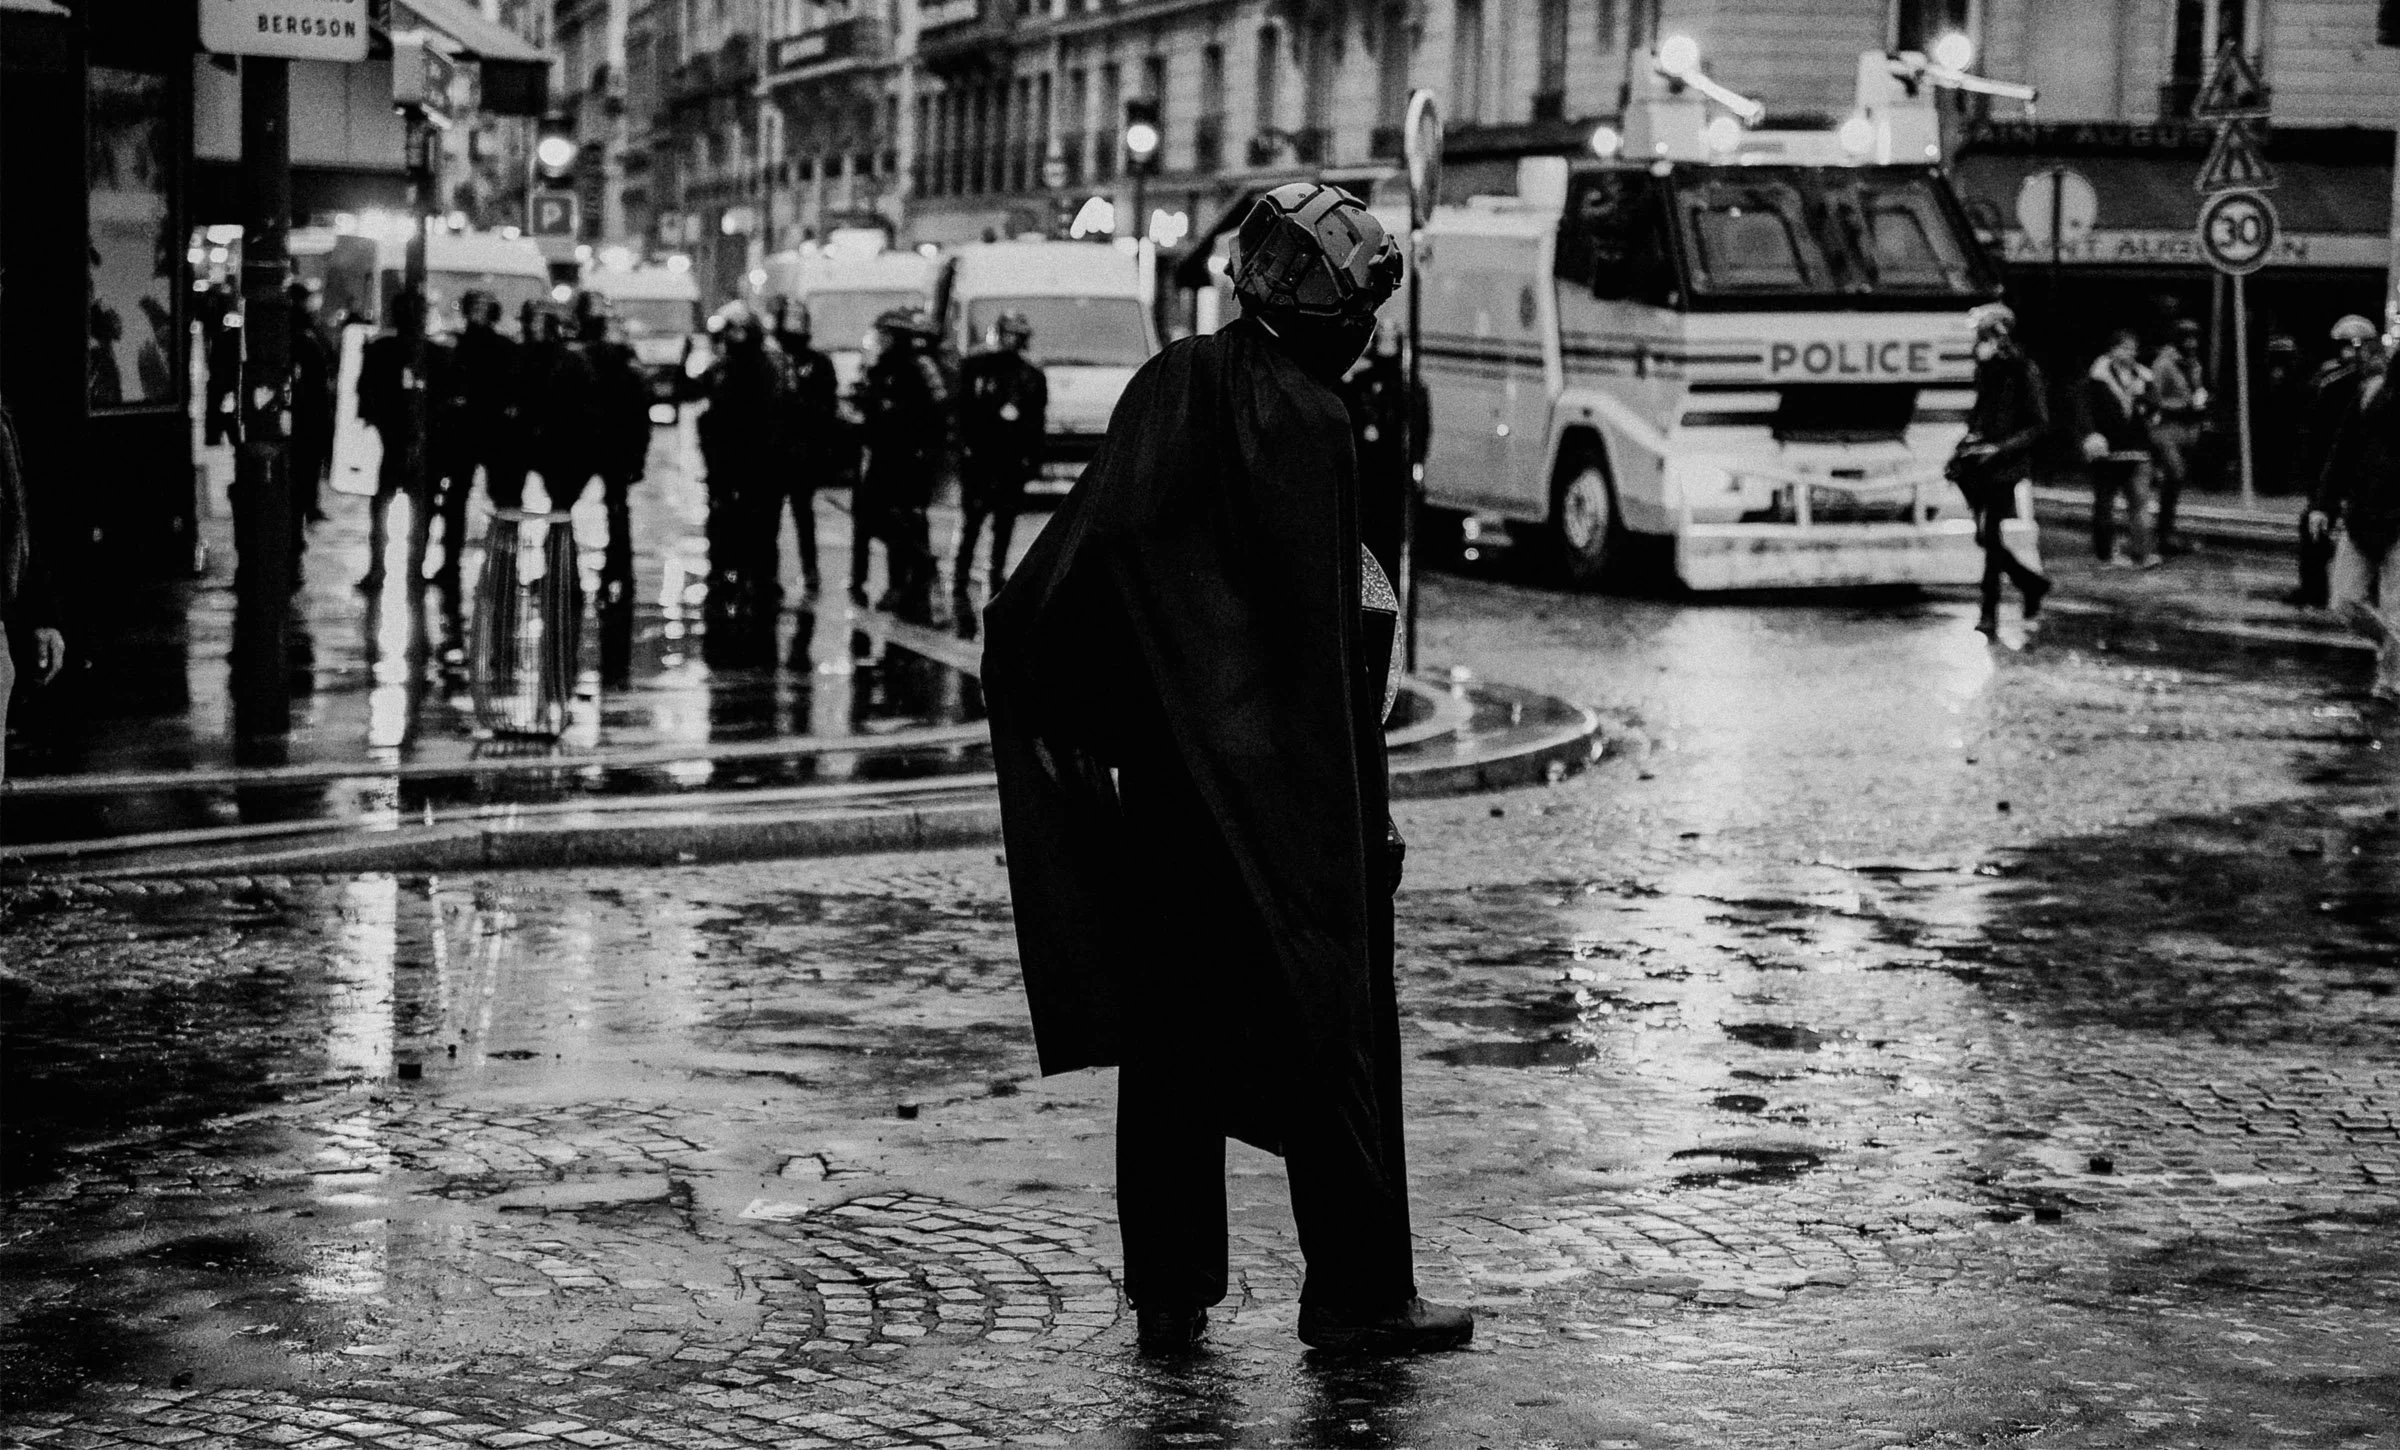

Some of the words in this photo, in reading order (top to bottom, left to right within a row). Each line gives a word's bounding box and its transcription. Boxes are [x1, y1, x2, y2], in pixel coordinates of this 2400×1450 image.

[257, 13, 356, 38] BERGSON
[2218, 215, 2261, 246] 30
[1771, 341, 1932, 374] POLICE
